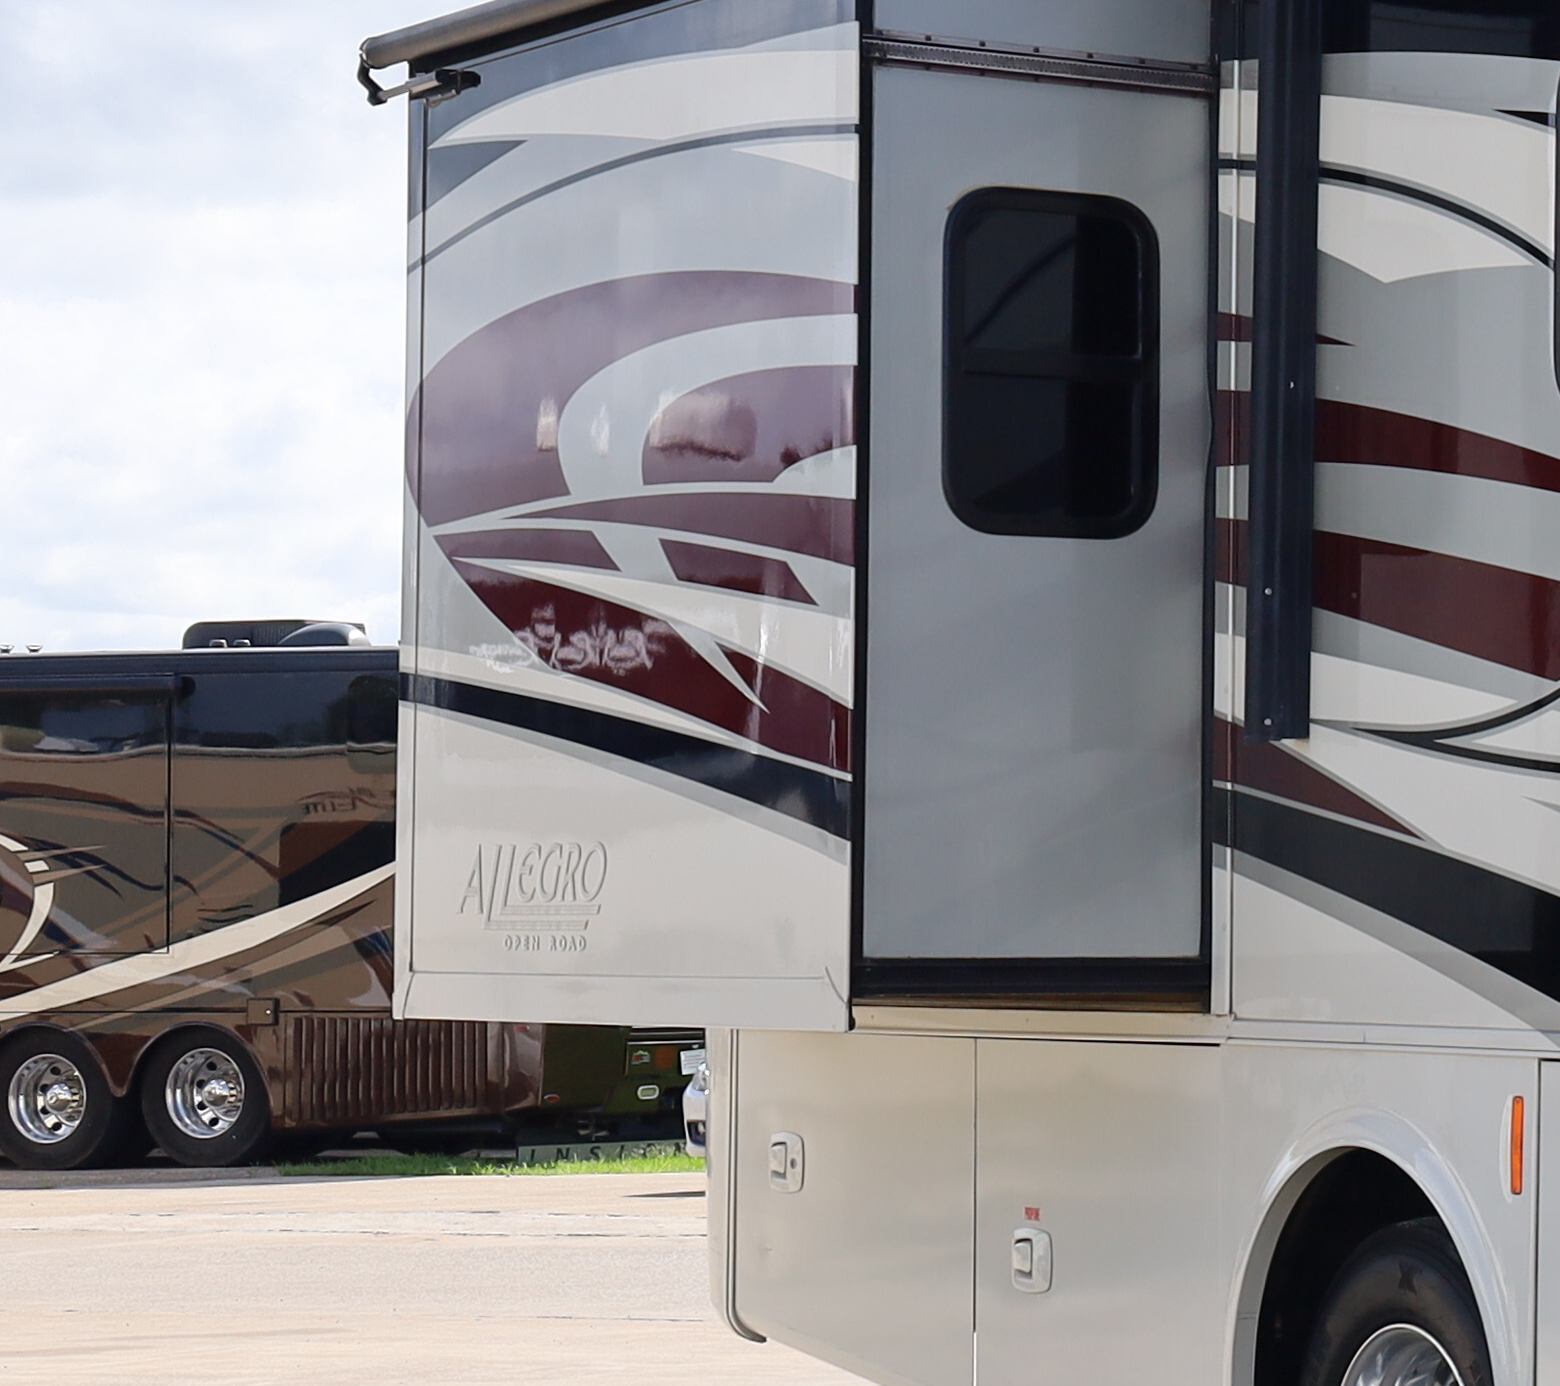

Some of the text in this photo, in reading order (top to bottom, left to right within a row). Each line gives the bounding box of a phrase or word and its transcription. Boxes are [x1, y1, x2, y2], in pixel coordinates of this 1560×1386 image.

[457, 841, 608, 930] ALLEGRO
[503, 935, 587, 951] OPEN ROAD
